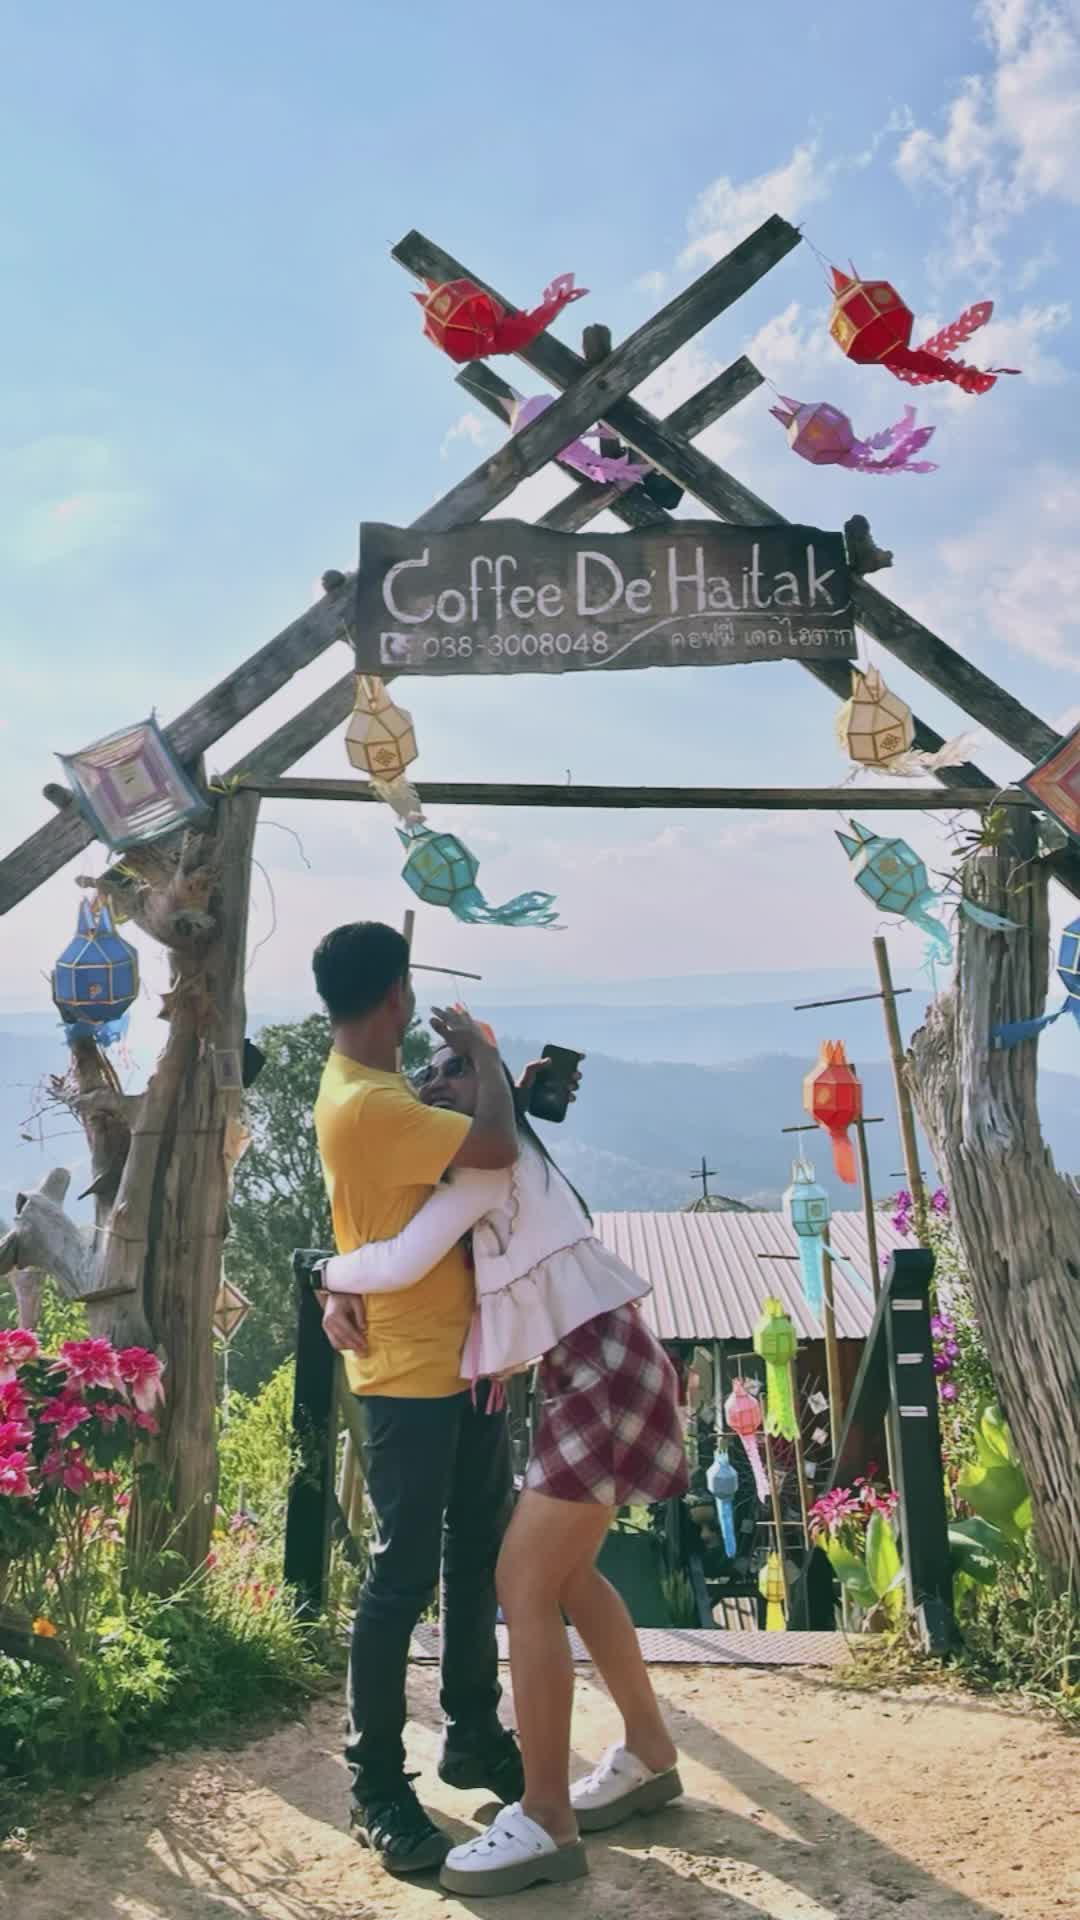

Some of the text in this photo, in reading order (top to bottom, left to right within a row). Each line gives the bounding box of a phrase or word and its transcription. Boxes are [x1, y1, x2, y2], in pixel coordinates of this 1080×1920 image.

[382, 548, 565, 625] Coffee
[668, 543, 836, 613] Haitak
[423, 631, 608, 658] 038-3008048
